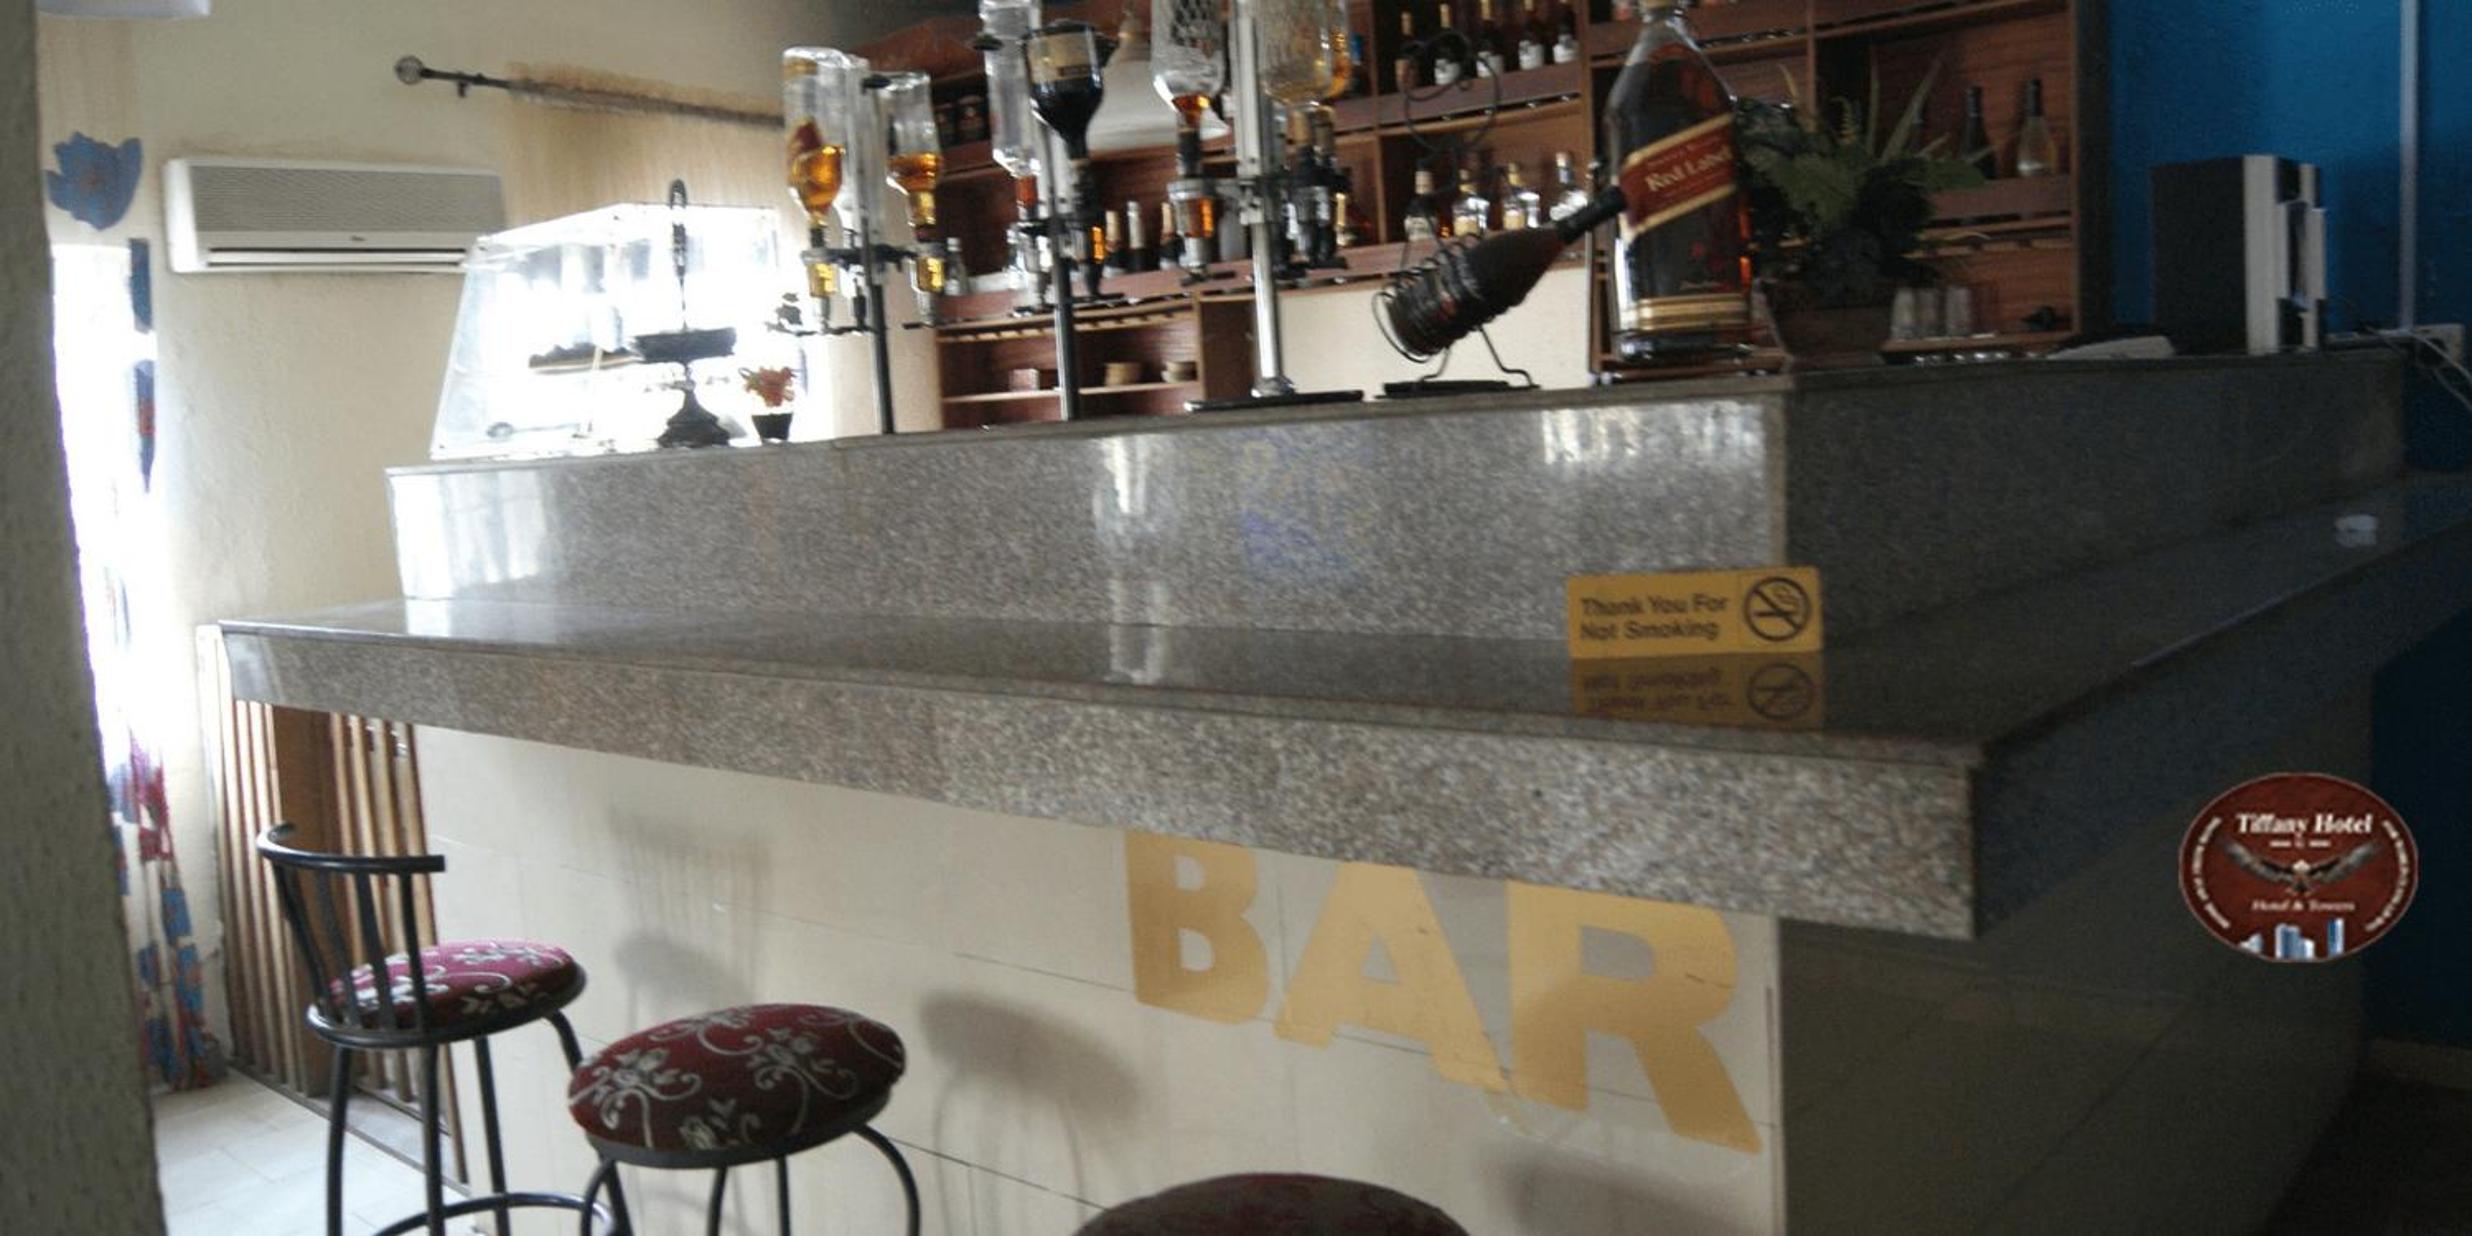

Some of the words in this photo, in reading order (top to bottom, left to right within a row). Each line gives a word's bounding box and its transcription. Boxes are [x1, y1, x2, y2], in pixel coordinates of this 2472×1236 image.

[1645, 166, 1685, 191] Red
[1581, 596, 1643, 615] Thank
[1648, 595, 1687, 613] You
[1692, 593, 1728, 611] For
[1581, 622, 1616, 640] Not
[1625, 620, 1719, 640] Smoking
[1124, 830, 1762, 1155] BAR
